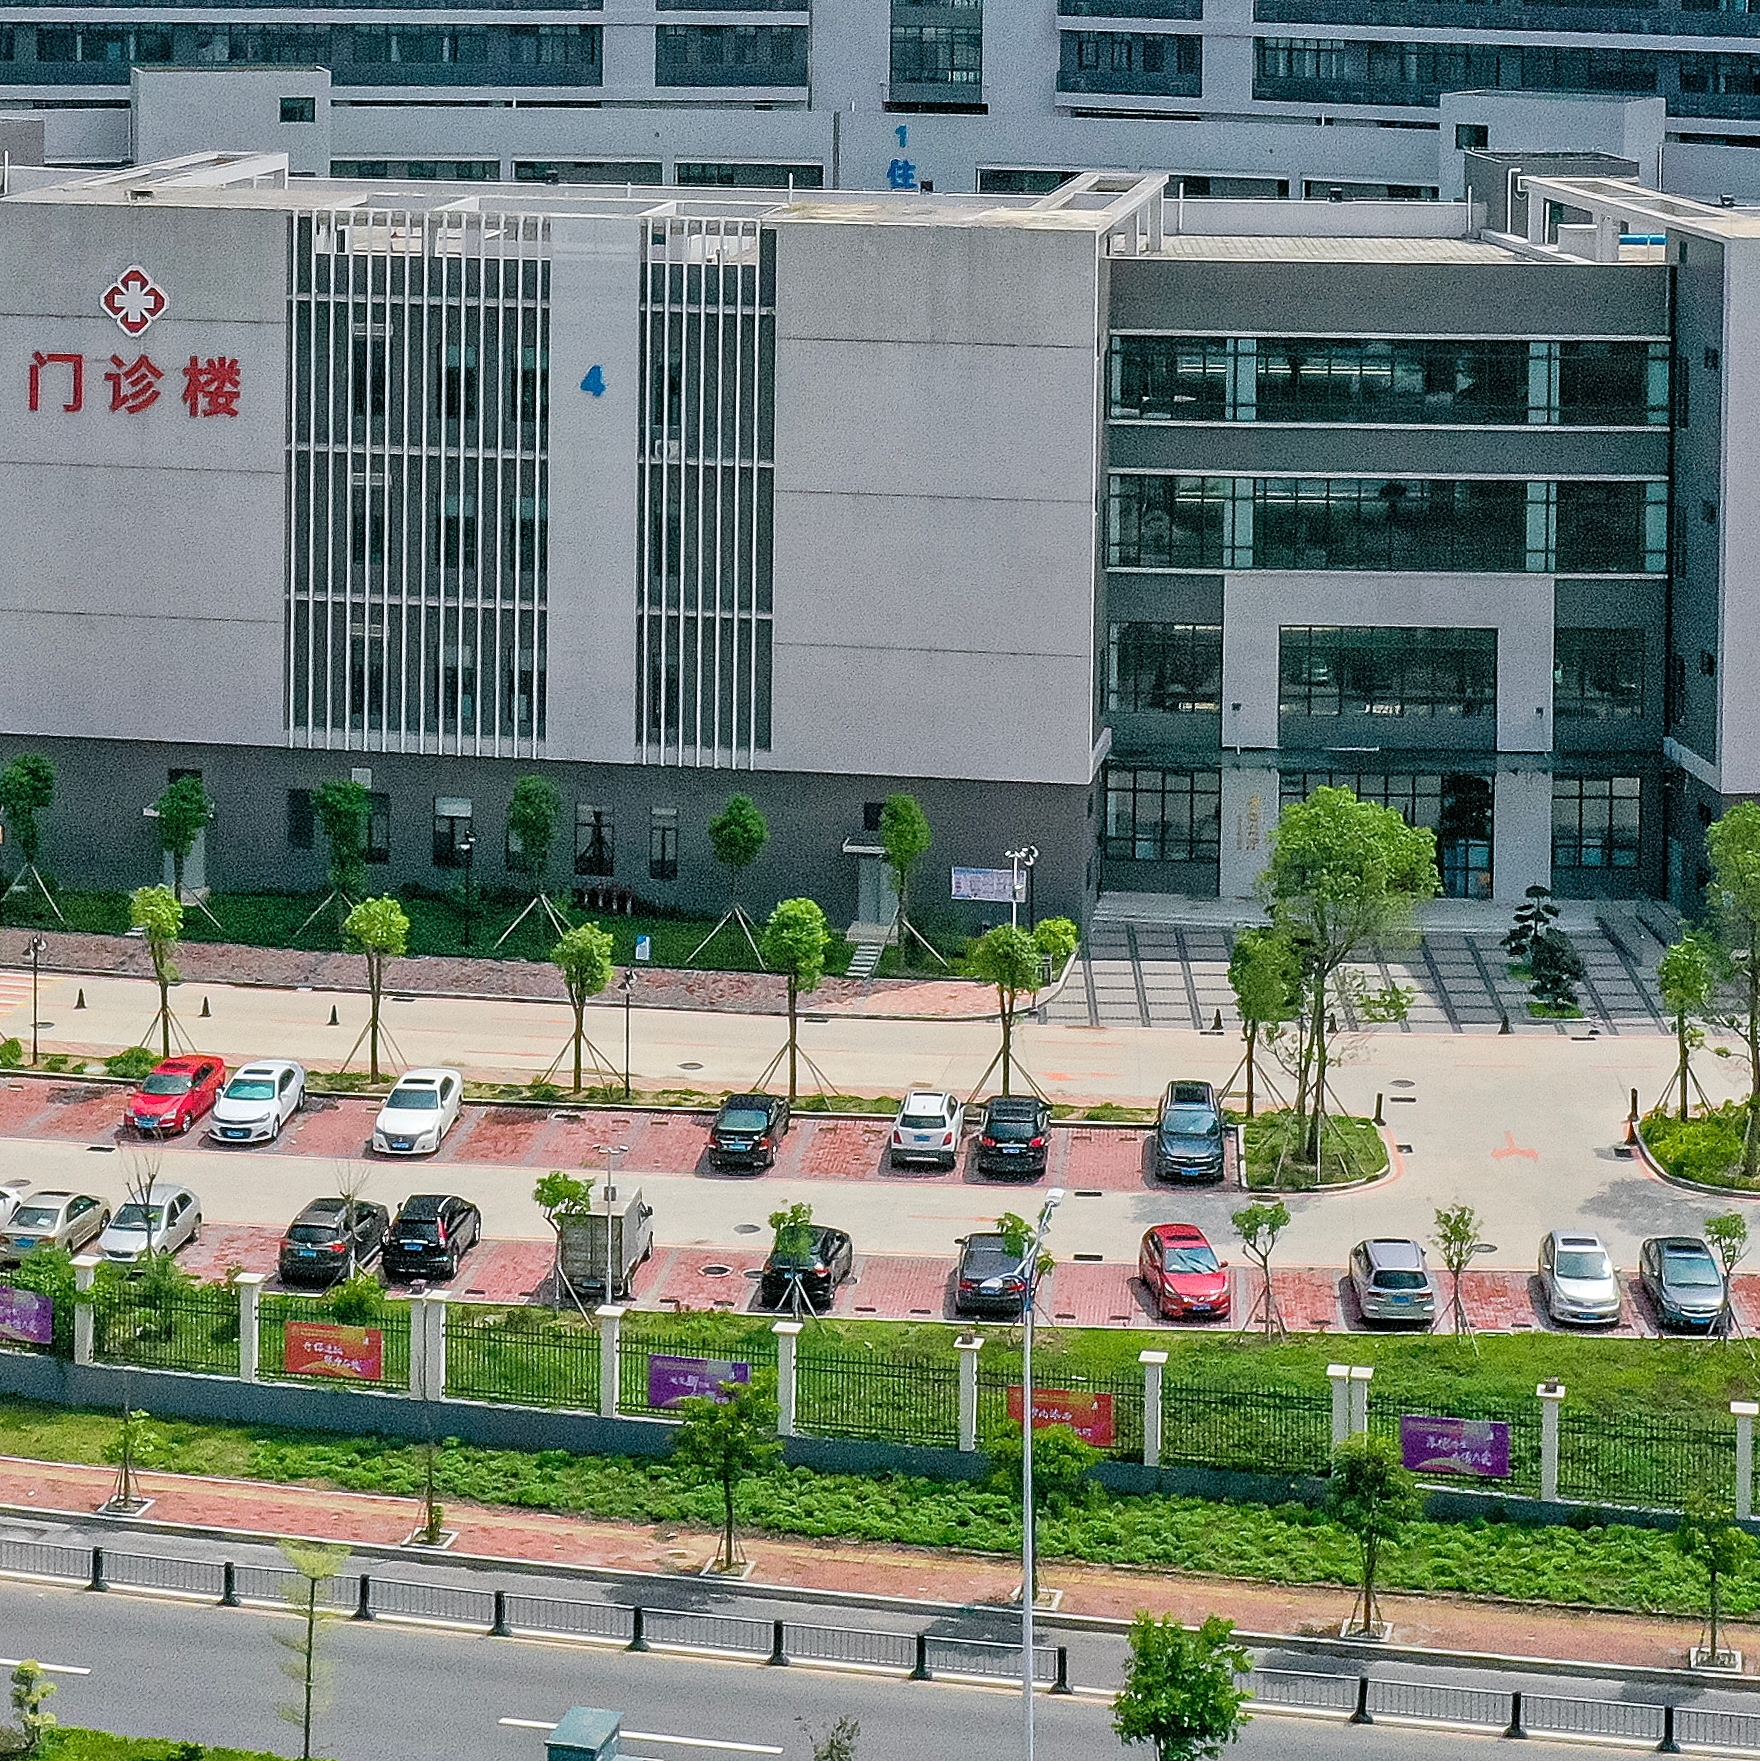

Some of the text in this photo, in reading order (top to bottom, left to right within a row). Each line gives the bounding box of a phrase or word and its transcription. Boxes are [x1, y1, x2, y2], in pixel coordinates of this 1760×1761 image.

[27, 351, 242, 419] 门诊楼
[580, 364, 607, 398] 4
